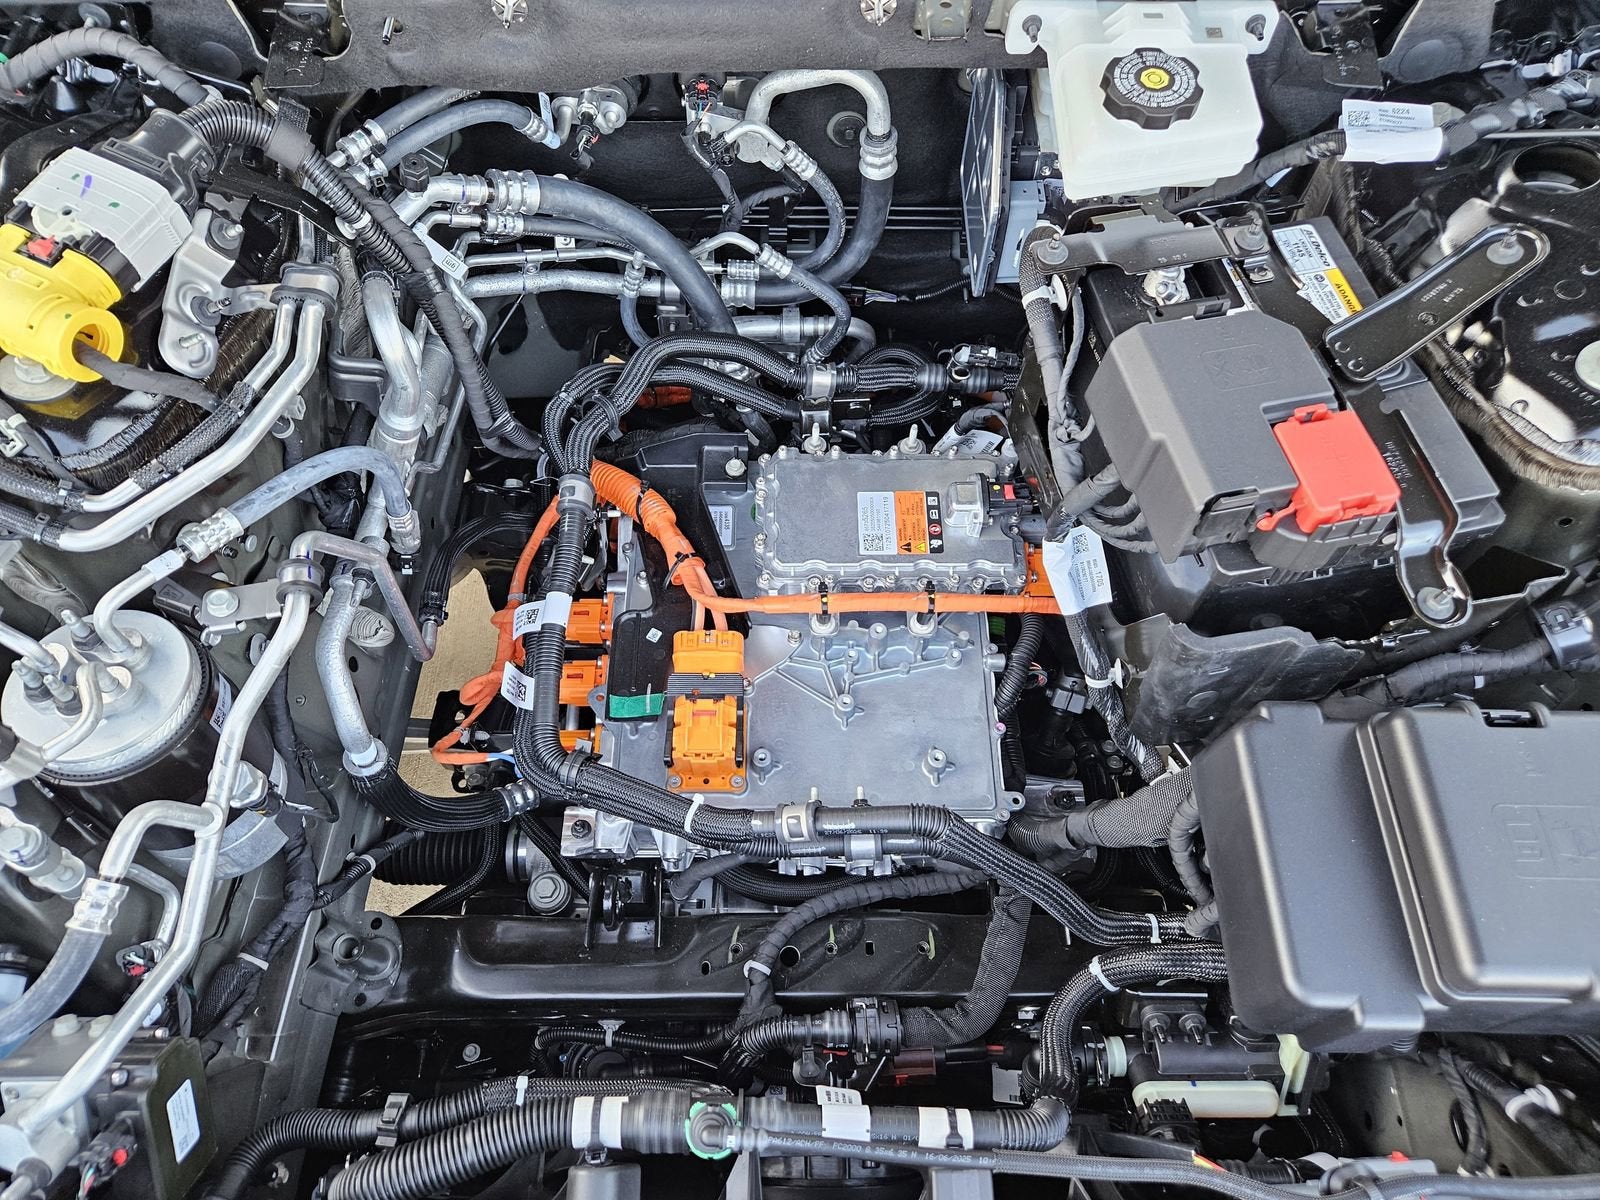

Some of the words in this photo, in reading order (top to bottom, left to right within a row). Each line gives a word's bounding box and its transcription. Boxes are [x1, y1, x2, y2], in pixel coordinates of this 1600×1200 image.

[1292, 242, 1306, 258] 1145
[1303, 228, 1331, 267] ACDelco
[1095, 571, 1105, 587] 1705
